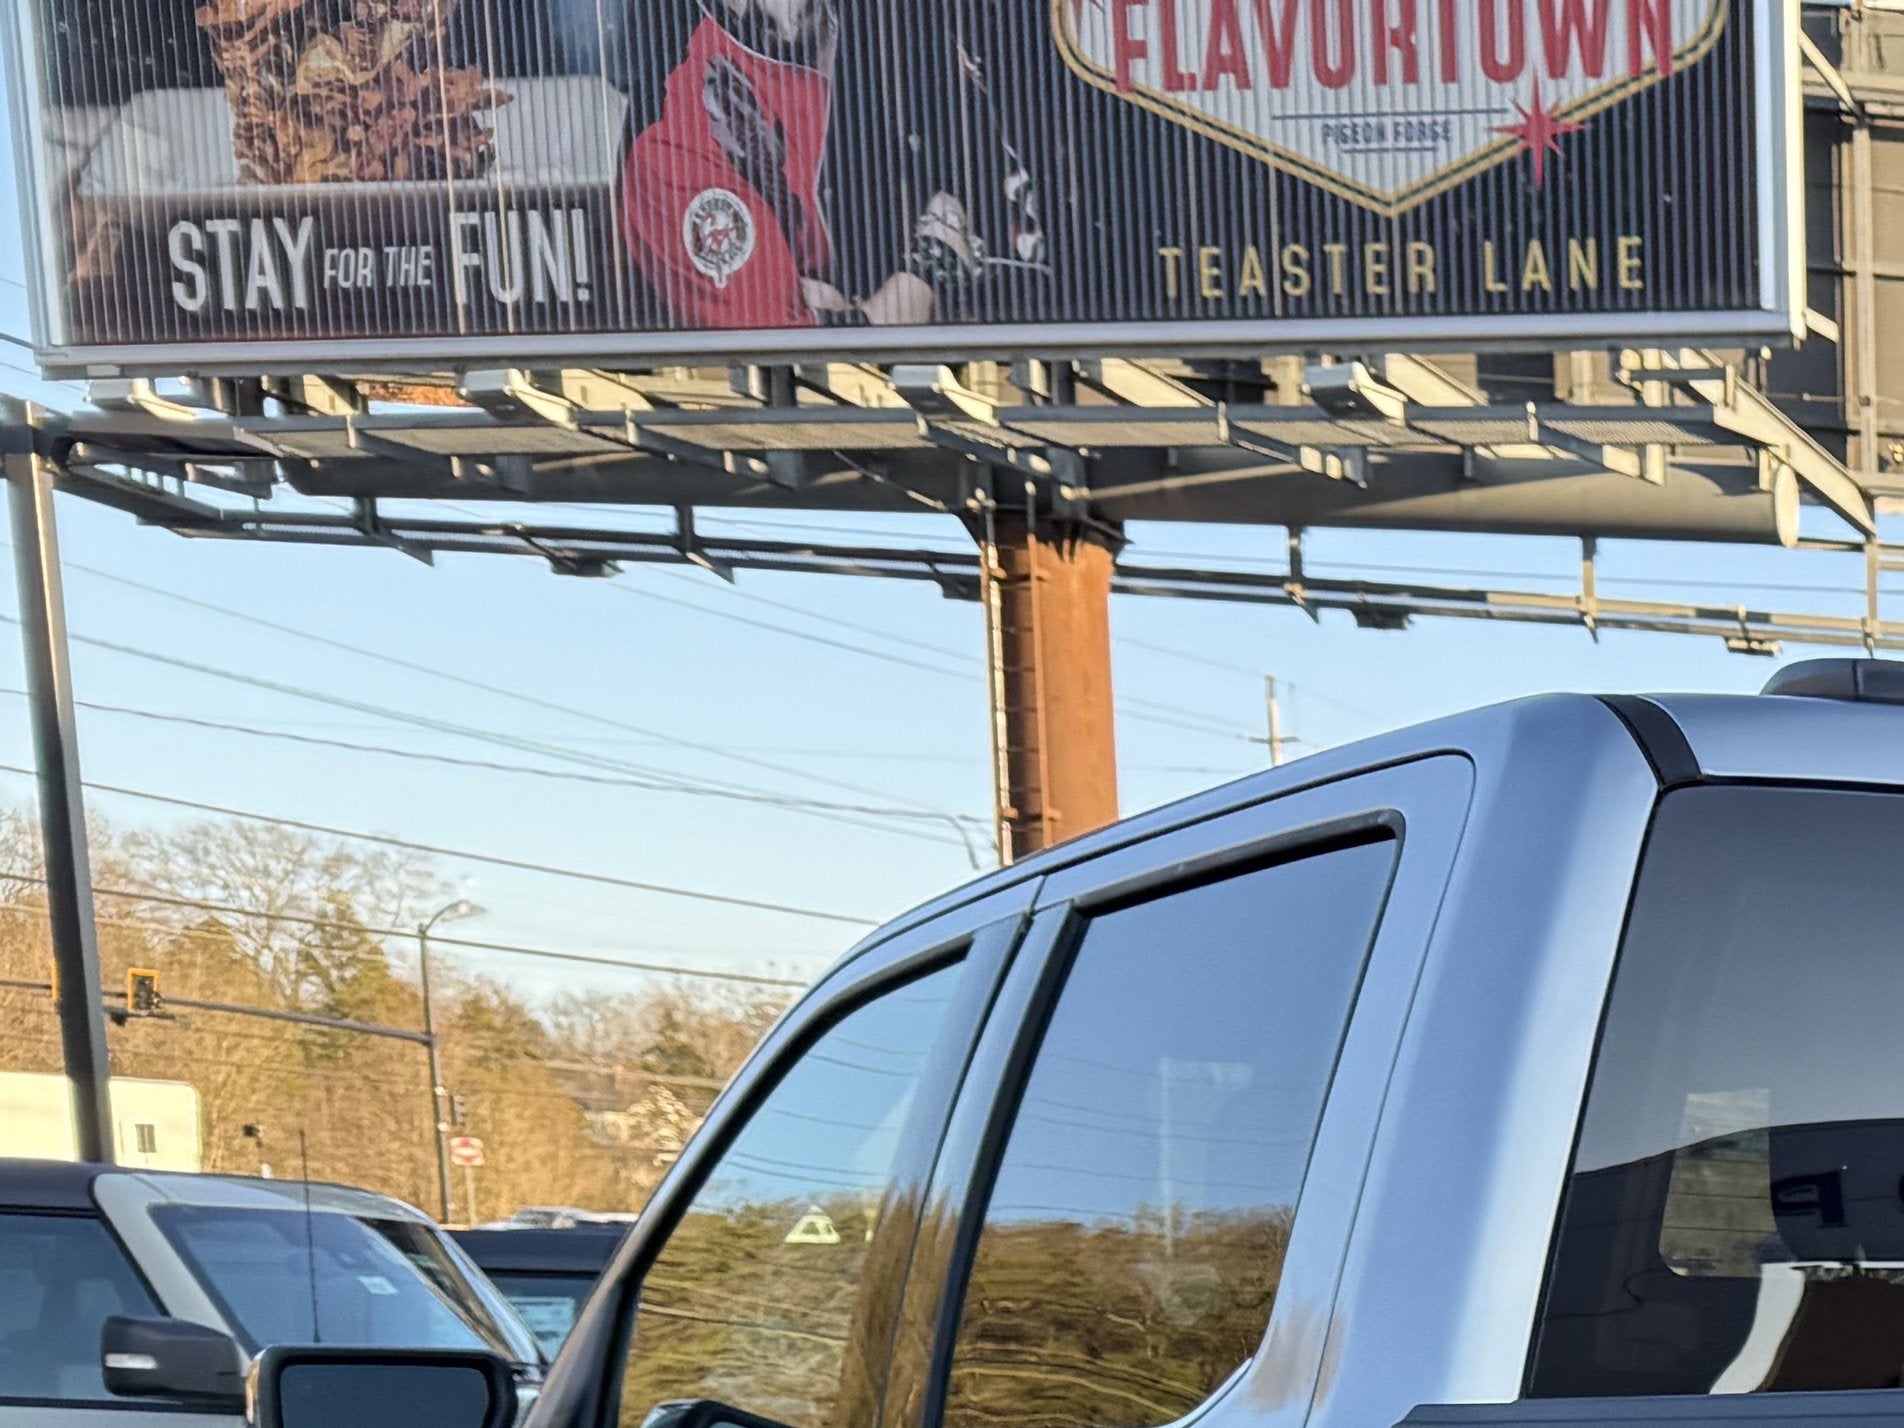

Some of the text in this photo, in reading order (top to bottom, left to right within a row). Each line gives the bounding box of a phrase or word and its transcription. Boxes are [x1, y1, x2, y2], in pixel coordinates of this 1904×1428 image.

[168, 208, 591, 313] STAY FOR THE FUN!
[1159, 236, 1645, 299] TEASTER LANE
